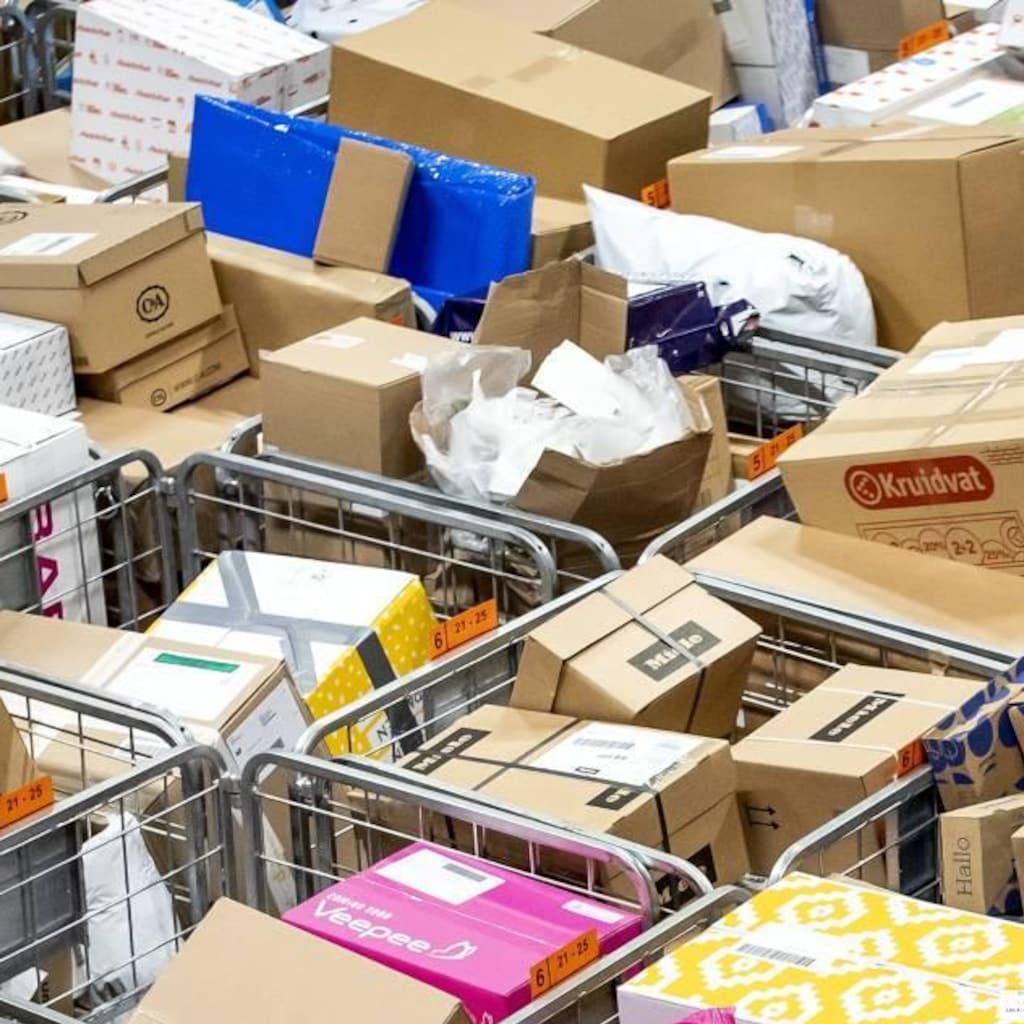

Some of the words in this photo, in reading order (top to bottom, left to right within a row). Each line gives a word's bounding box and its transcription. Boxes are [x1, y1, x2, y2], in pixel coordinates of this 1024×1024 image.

[753, 457, 761, 471] 5
[879, 466, 985, 499] Kruidvat
[434, 632, 442, 648] 6
[455, 621, 466, 634] 21
[475, 611, 486, 624] 25
[902, 750, 910, 766] 6
[7, 798, 17, 811] 21
[29, 786, 43, 799] 25
[957, 836, 972, 896] Hallo
[314, 900, 431, 953] Veepee
[536, 968, 545, 987] 6
[557, 952, 568, 967] 21
[576, 939, 588, 955] 25
